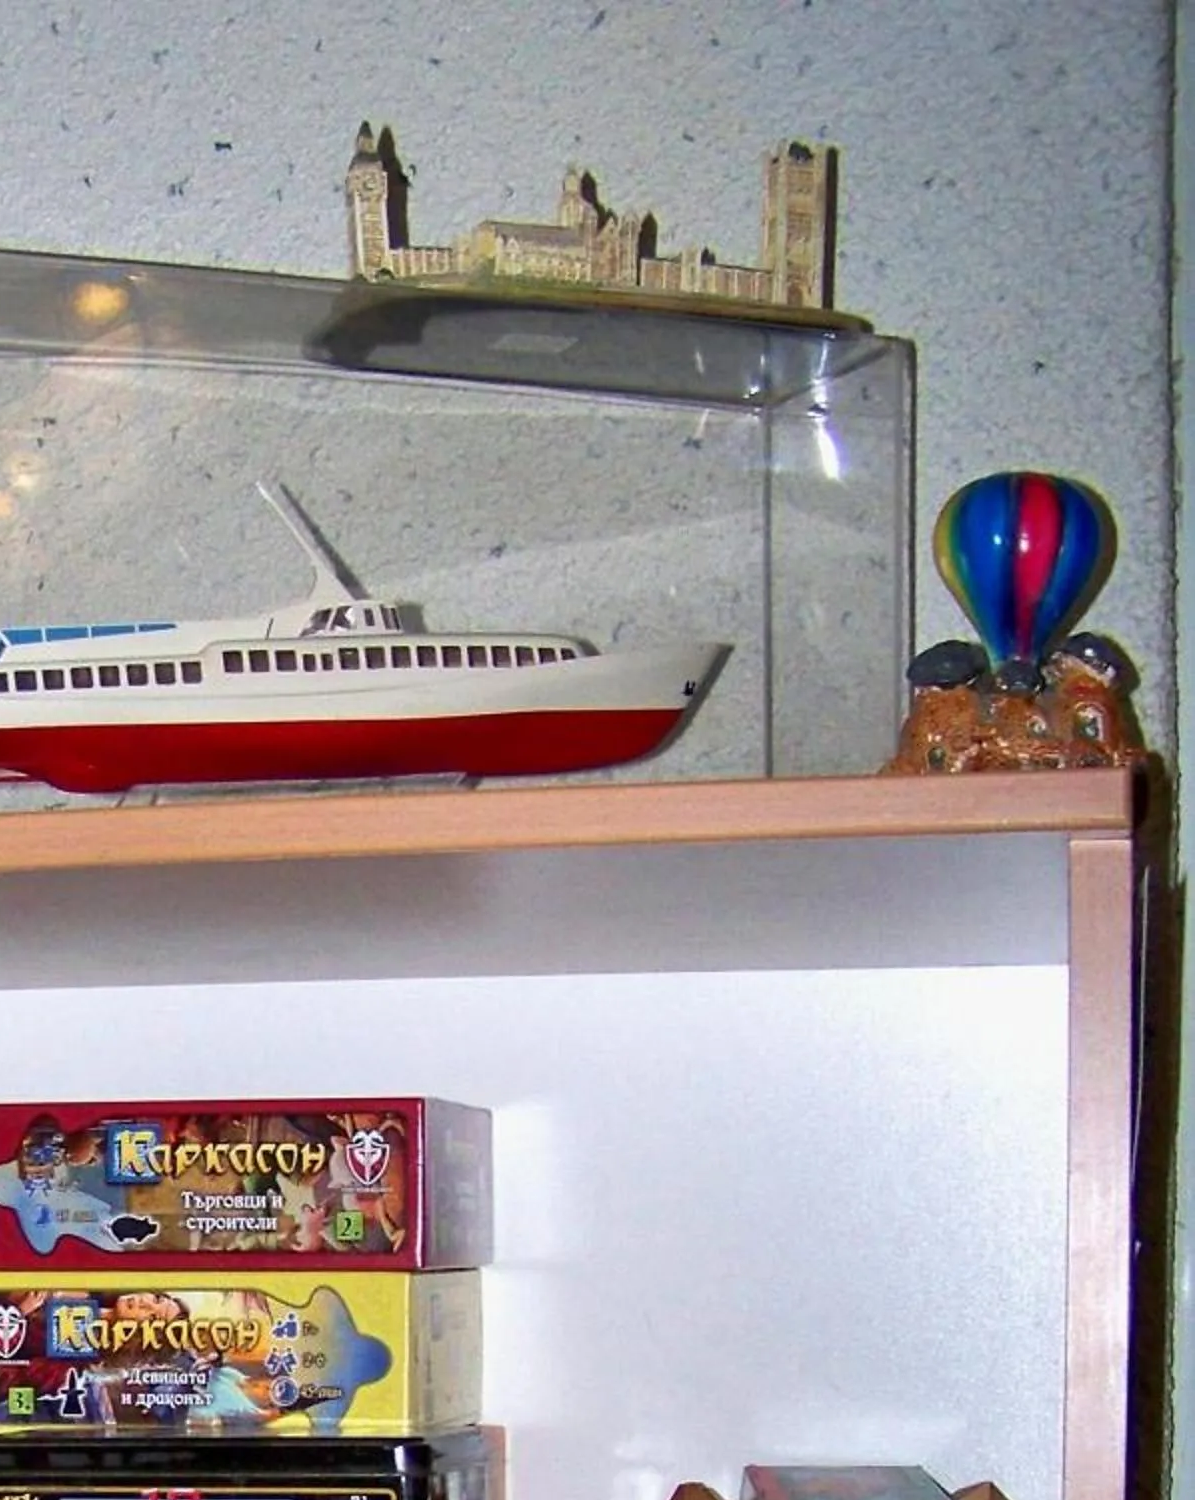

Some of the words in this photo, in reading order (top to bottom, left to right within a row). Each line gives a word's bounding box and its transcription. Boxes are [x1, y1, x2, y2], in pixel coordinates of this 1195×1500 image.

[116, 1129, 327, 1175] Каркасон
[181, 1191, 267, 1211] Търговци
[270, 1195, 283, 1209] и
[186, 1216, 278, 1232] строители
[54, 1305, 261, 1353] Каркасон
[121, 1393, 135, 1406] и
